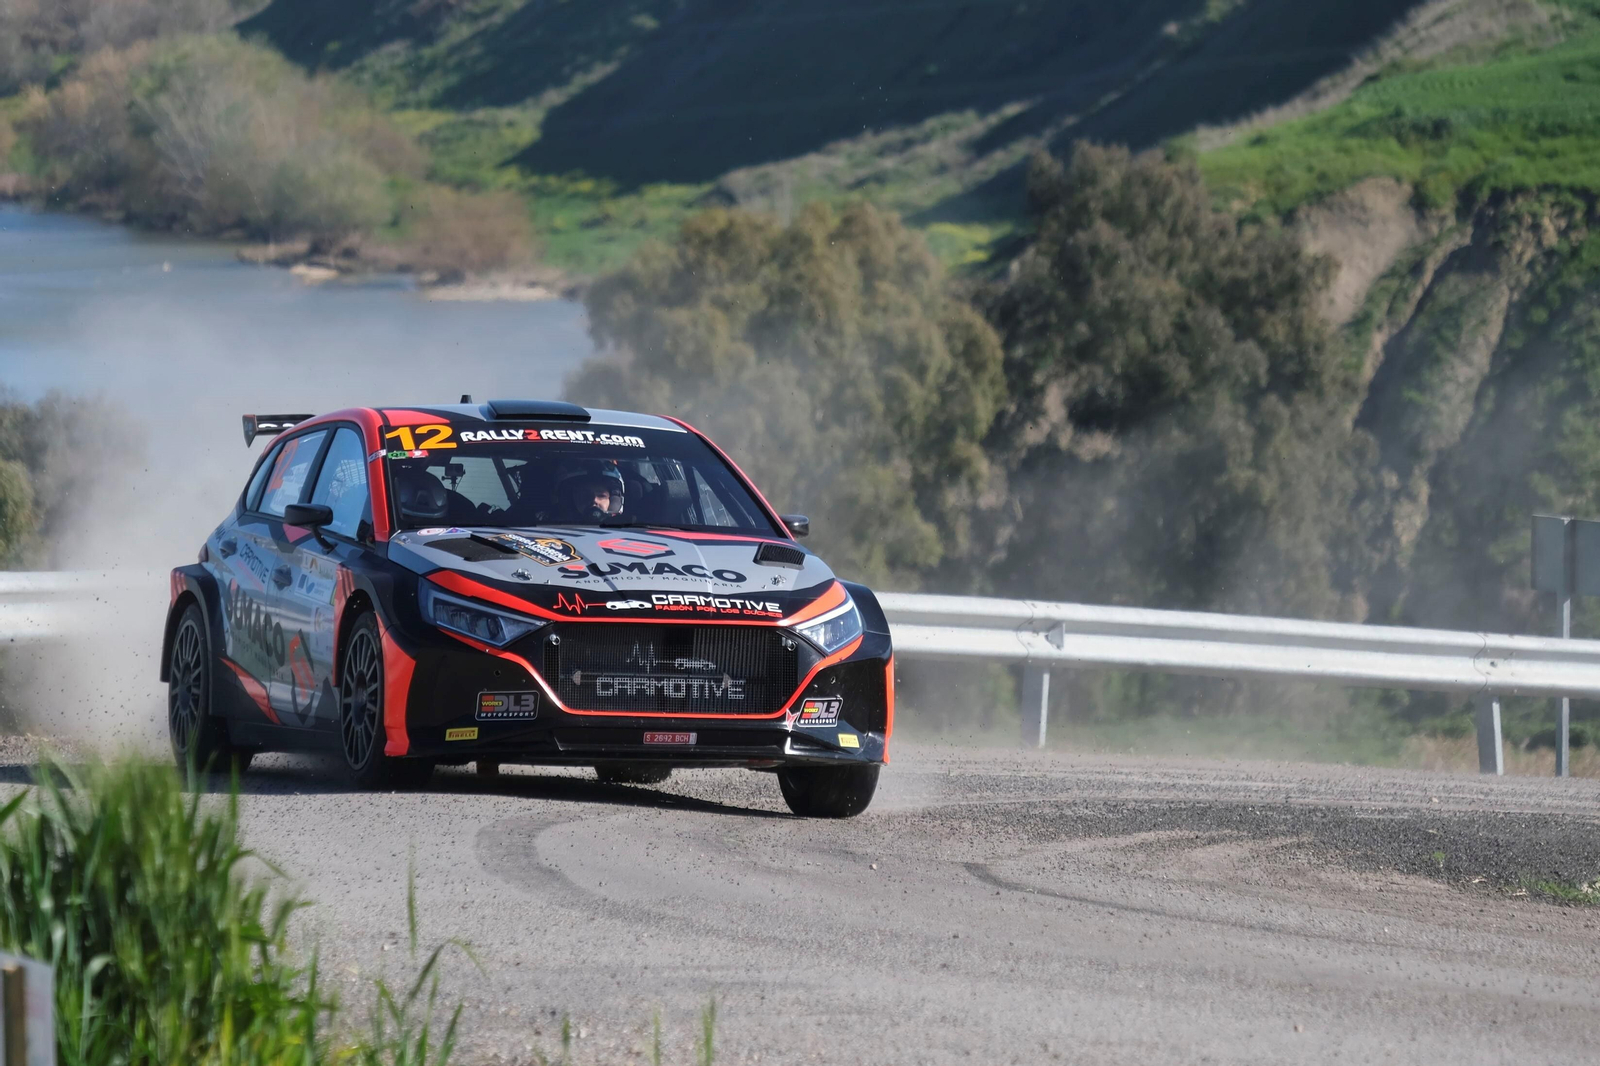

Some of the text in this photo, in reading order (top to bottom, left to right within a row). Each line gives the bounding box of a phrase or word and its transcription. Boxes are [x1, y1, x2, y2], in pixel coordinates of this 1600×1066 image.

[385, 424, 458, 451] 12
[558, 562, 747, 583] SUMACO
[575, 576, 642, 584] ANDAMIOS
[662, 576, 743, 589] MAQUINARIA
[651, 594, 783, 613] CARMOTIVE
[596, 677, 745, 699] CARMOTIVE
